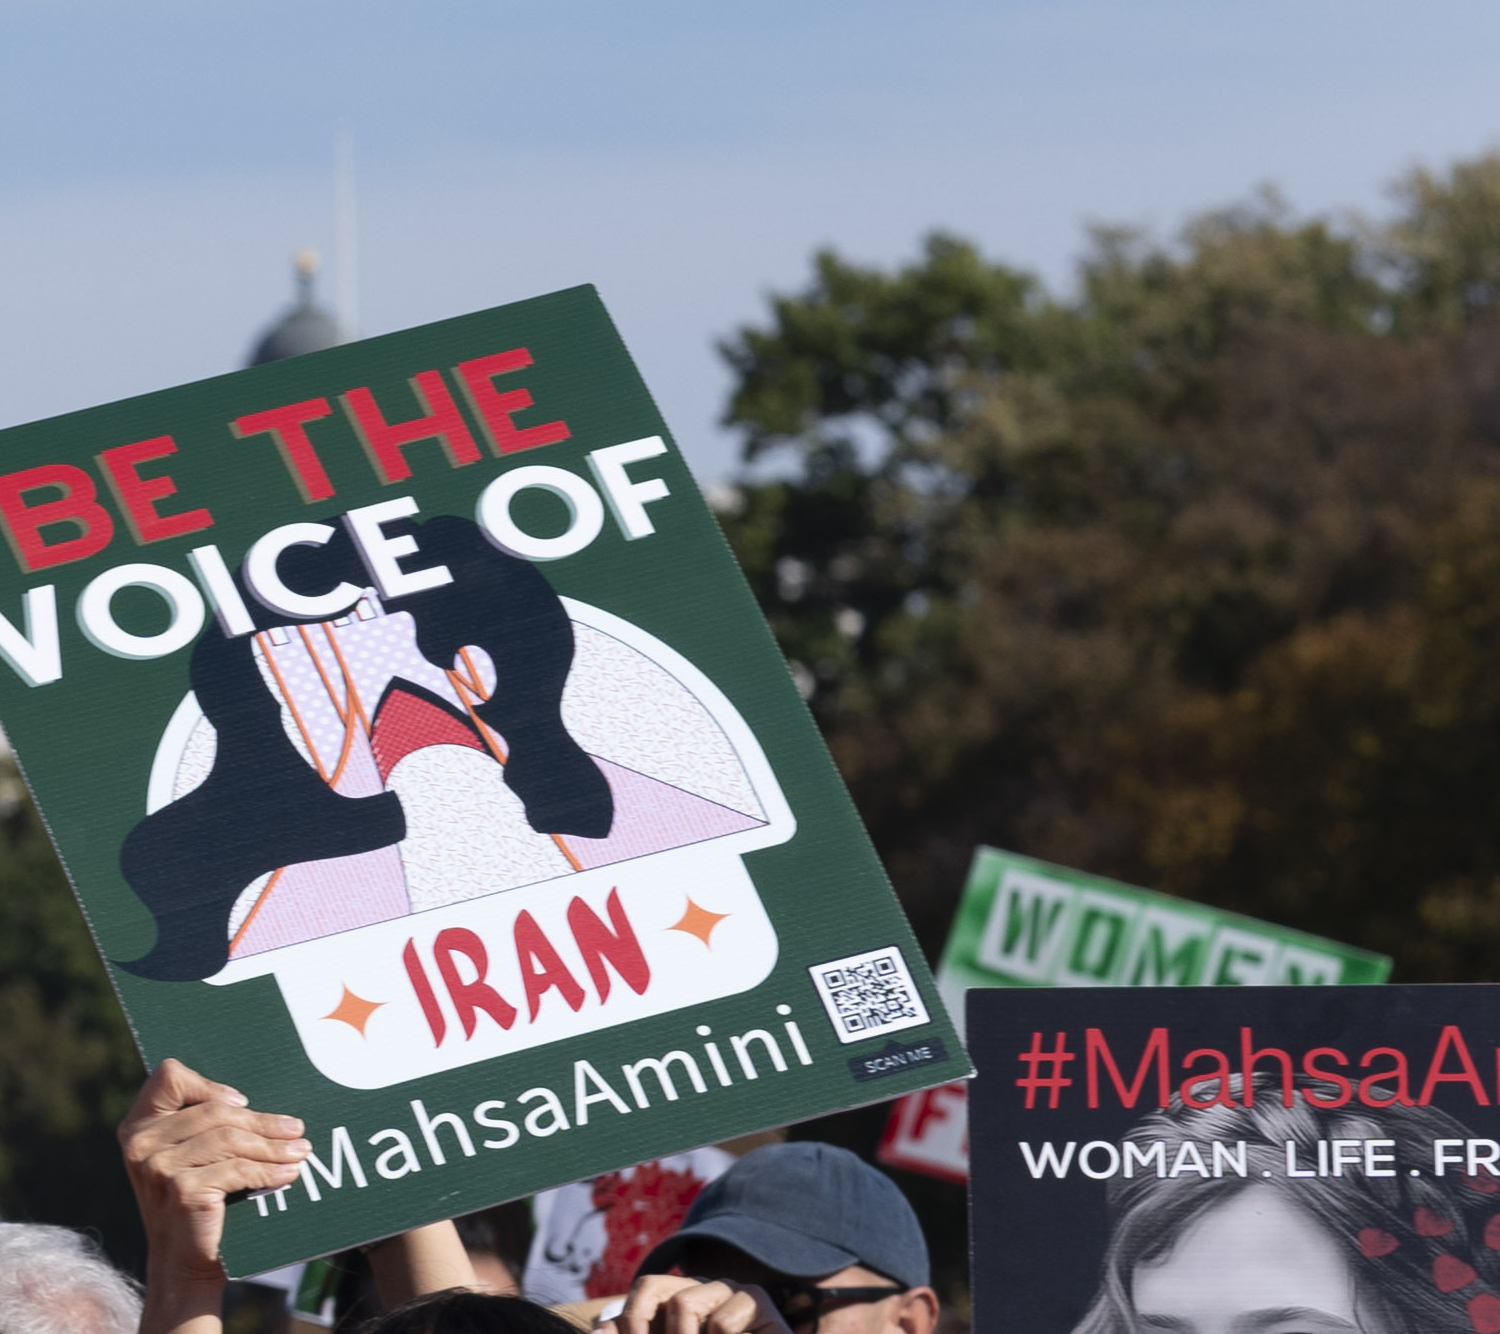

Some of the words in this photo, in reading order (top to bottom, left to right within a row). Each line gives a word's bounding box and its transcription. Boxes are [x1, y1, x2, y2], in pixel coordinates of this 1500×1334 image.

[230, 347, 573, 505] THE
[474, 435, 674, 564] OF
[401, 886, 652, 1049] IRAN
[864, 1053, 908, 1074] SCAN
[908, 1046, 933, 1062] ME
[1015, 1025, 1500, 1108] #MahsaA
[1018, 1140, 1248, 1179] WOMAN
[1285, 1139, 1397, 1178] LIFE
[1433, 1138, 1500, 1177] FR
